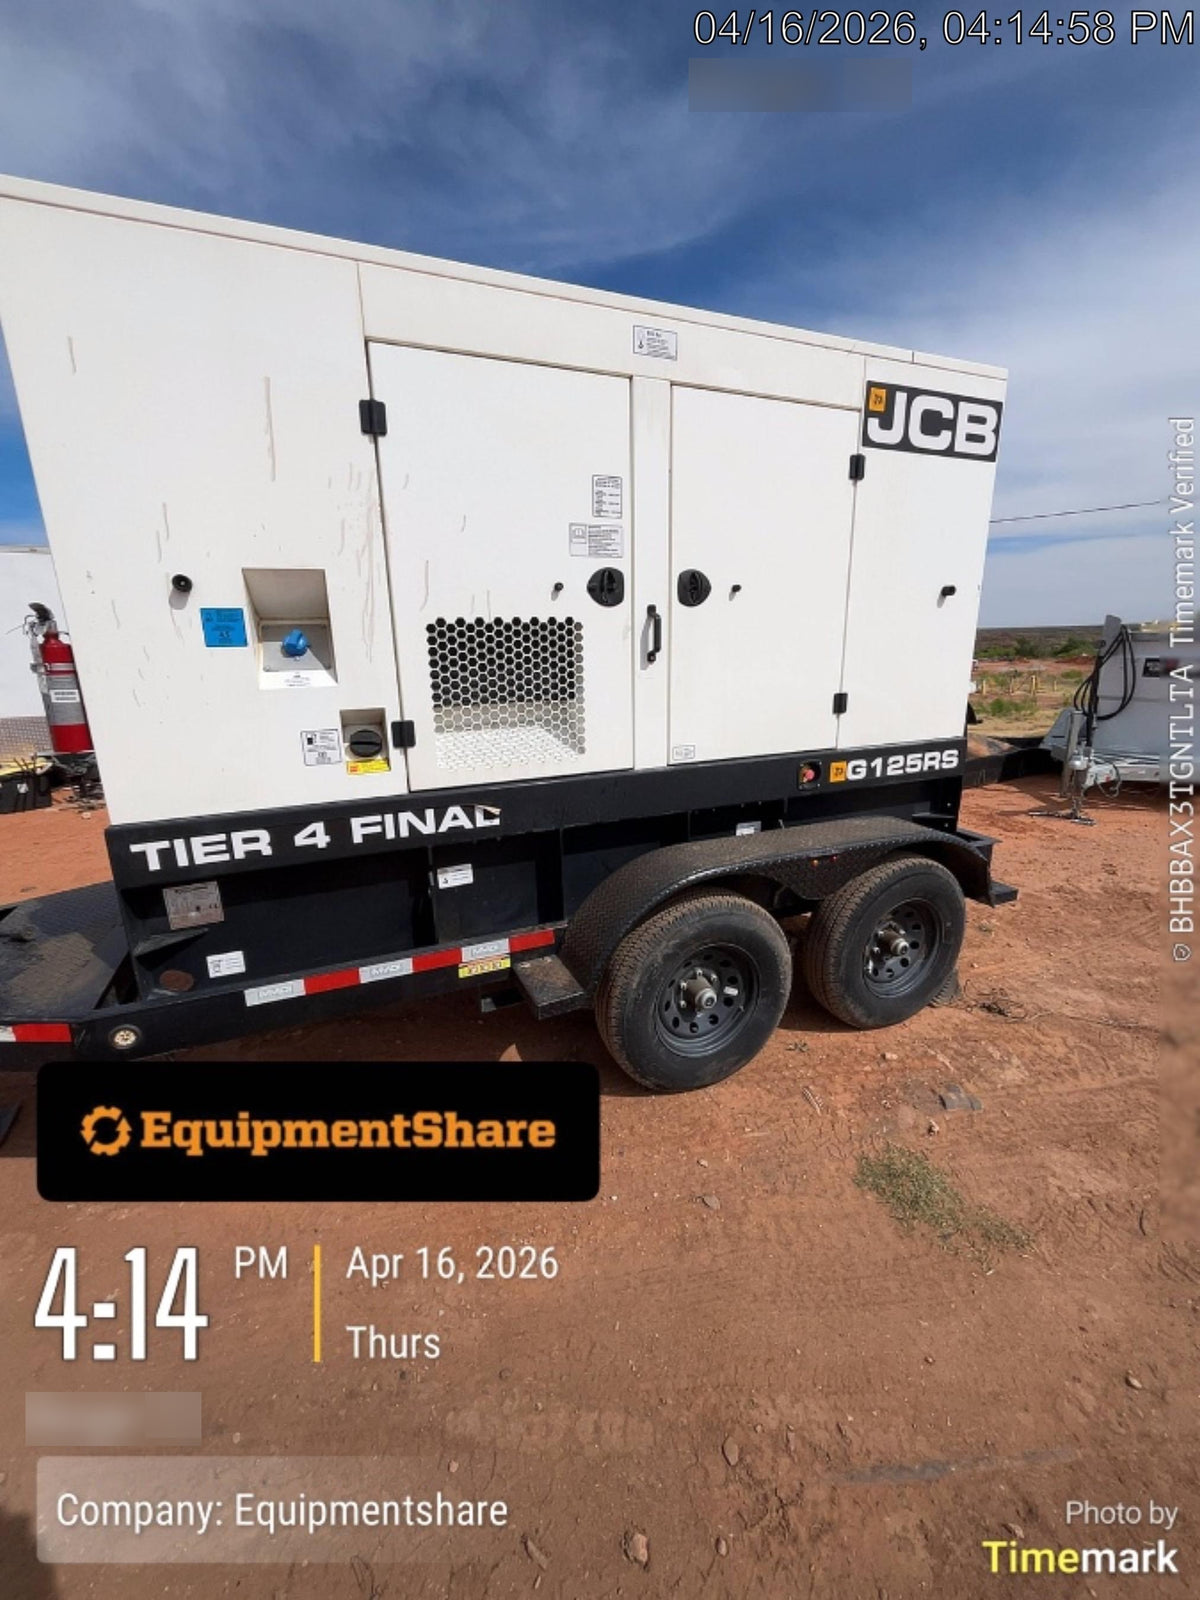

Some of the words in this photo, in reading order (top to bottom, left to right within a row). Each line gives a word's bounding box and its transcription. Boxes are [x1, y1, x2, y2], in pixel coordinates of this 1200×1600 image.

[867, 391, 998, 456] JCB
[846, 749, 959, 781] G125RS
[129, 829, 273, 872] TIER
[293, 822, 331, 849] 4
[350, 804, 501, 845] FINAL
